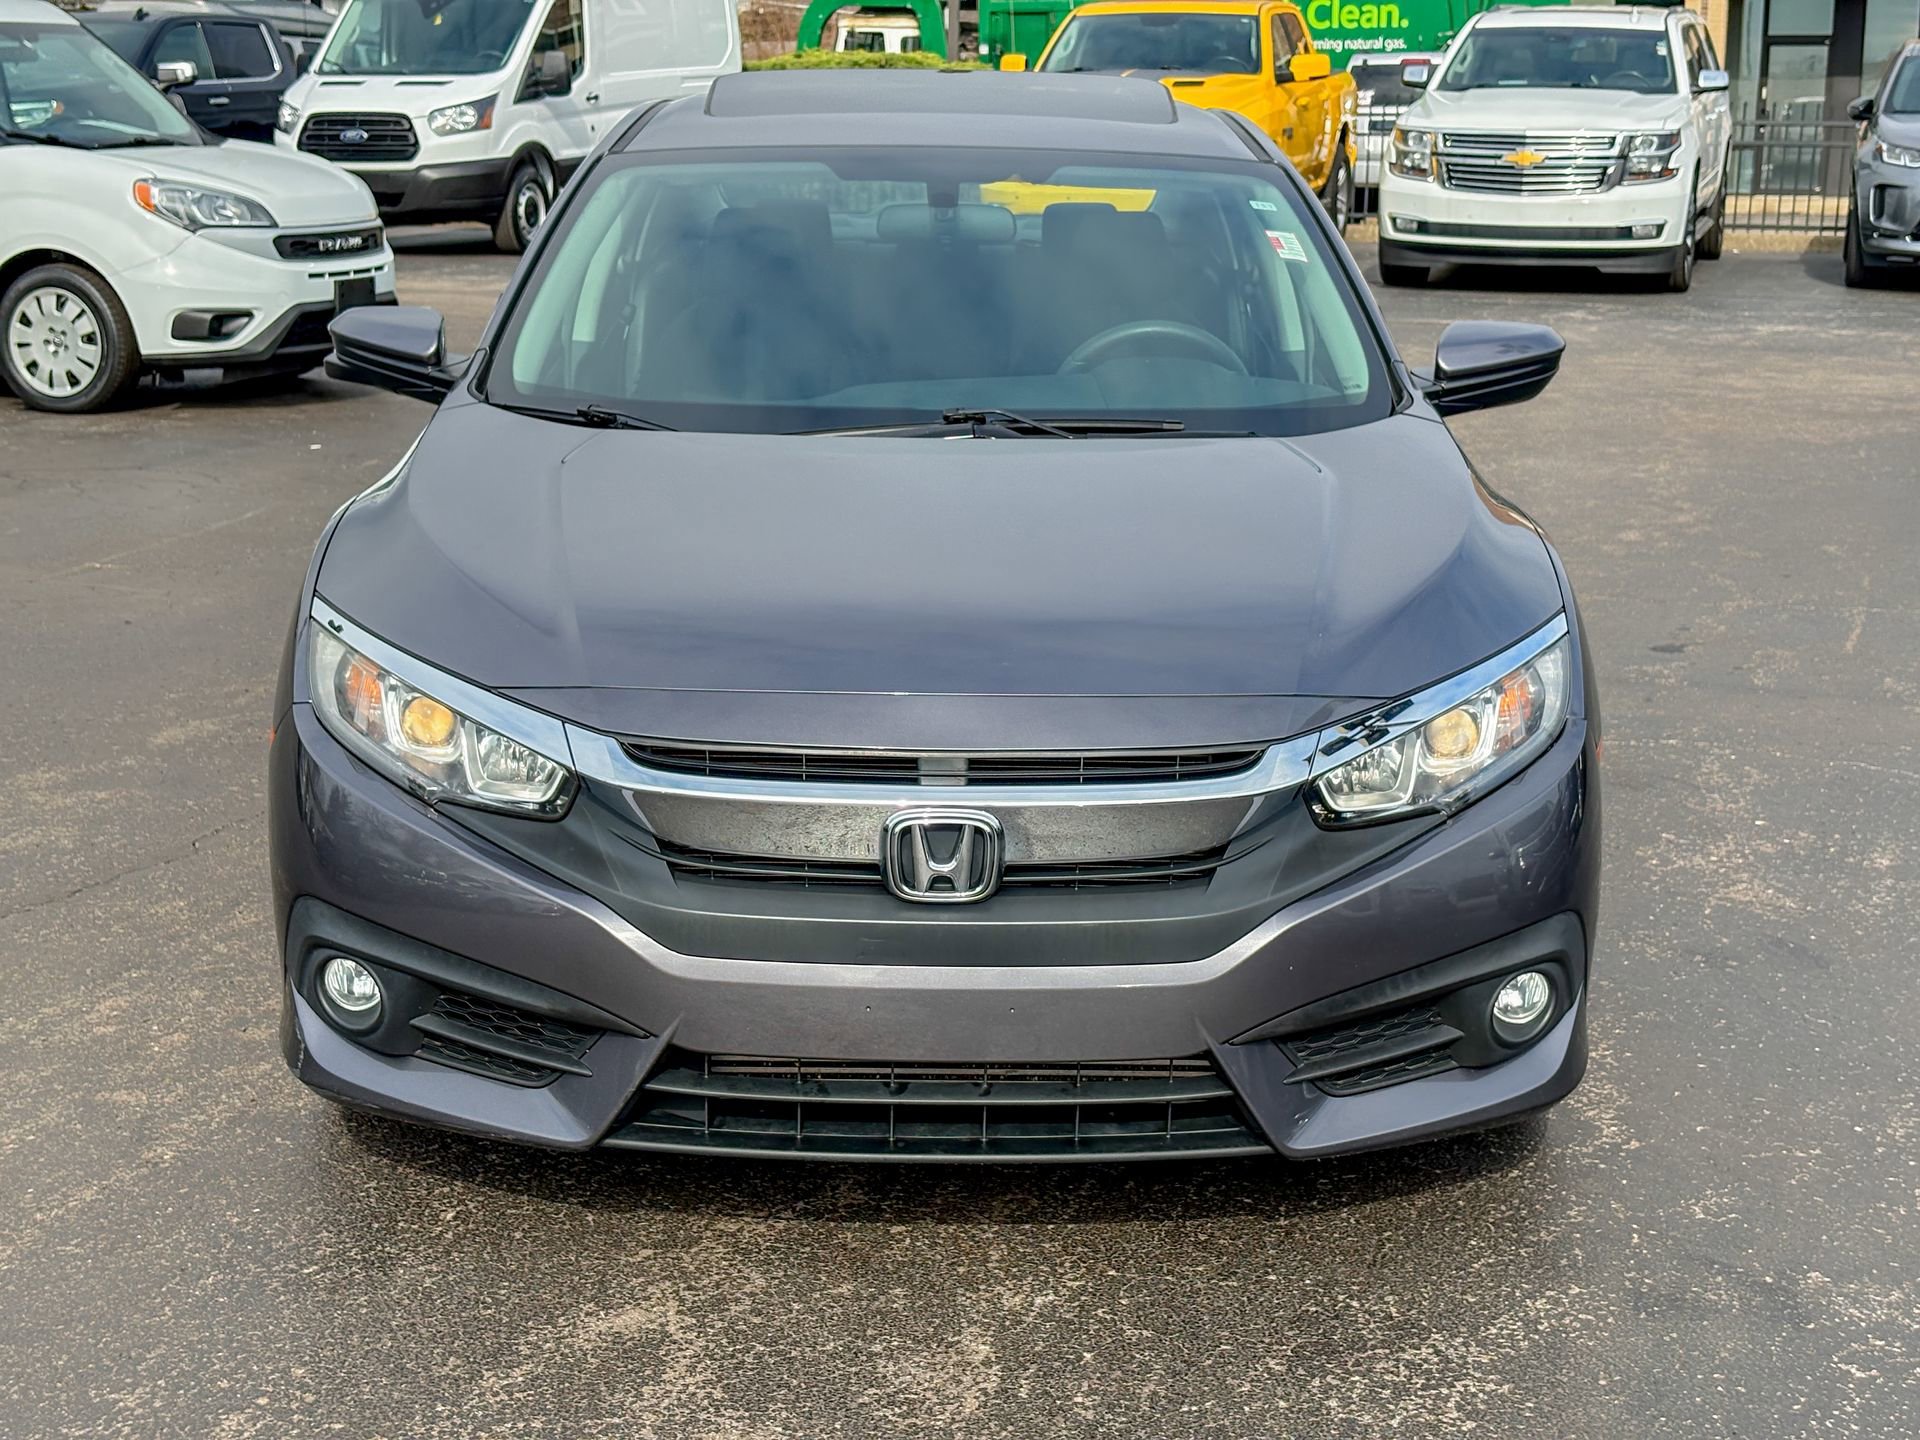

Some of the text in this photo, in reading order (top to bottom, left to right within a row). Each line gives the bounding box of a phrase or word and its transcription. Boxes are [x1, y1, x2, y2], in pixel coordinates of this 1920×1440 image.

[1307, 0, 1409, 29] Clean.
[1344, 36, 1383, 50] natural
[1384, 38, 1407, 52] gas.
